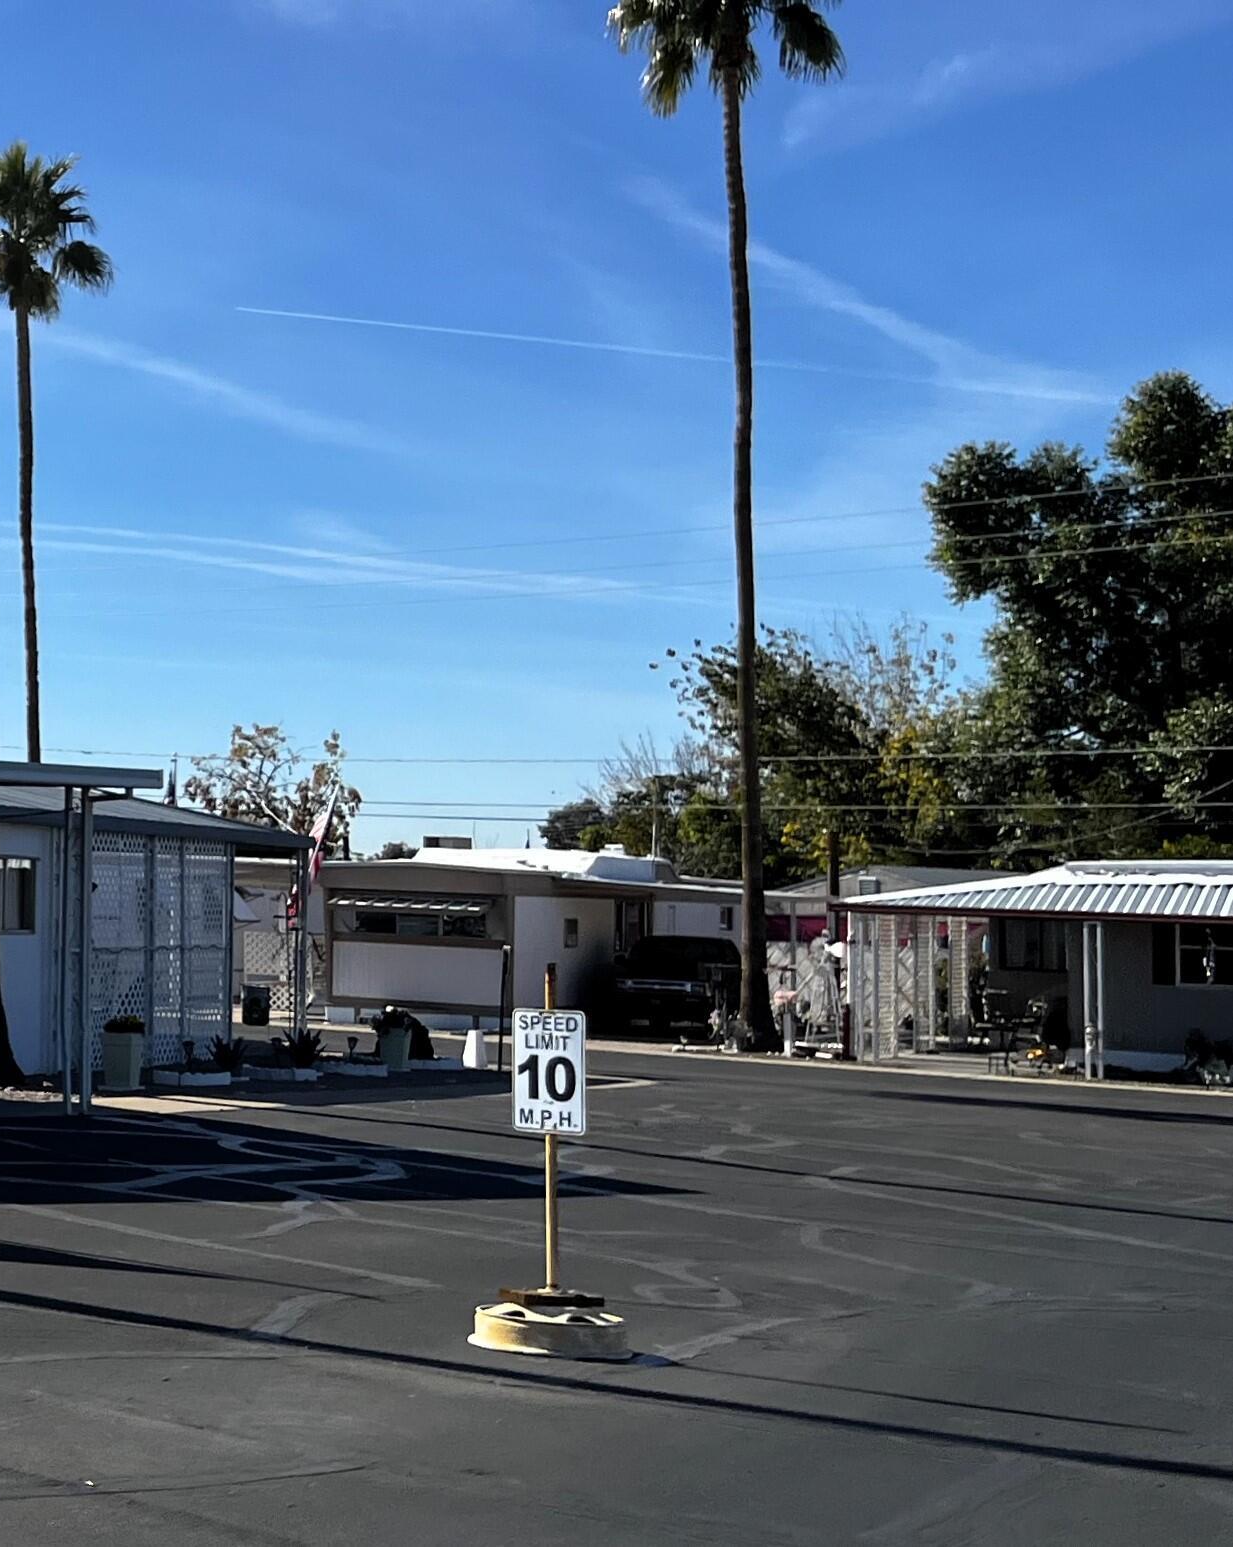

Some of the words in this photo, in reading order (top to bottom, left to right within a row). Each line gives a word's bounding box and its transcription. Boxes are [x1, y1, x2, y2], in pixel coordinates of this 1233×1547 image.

[518, 1015, 579, 1033] SPEED
[524, 1034, 571, 1051] LIMIT
[517, 1054, 577, 1103] 10
[519, 1108, 579, 1129] M.P.H.
